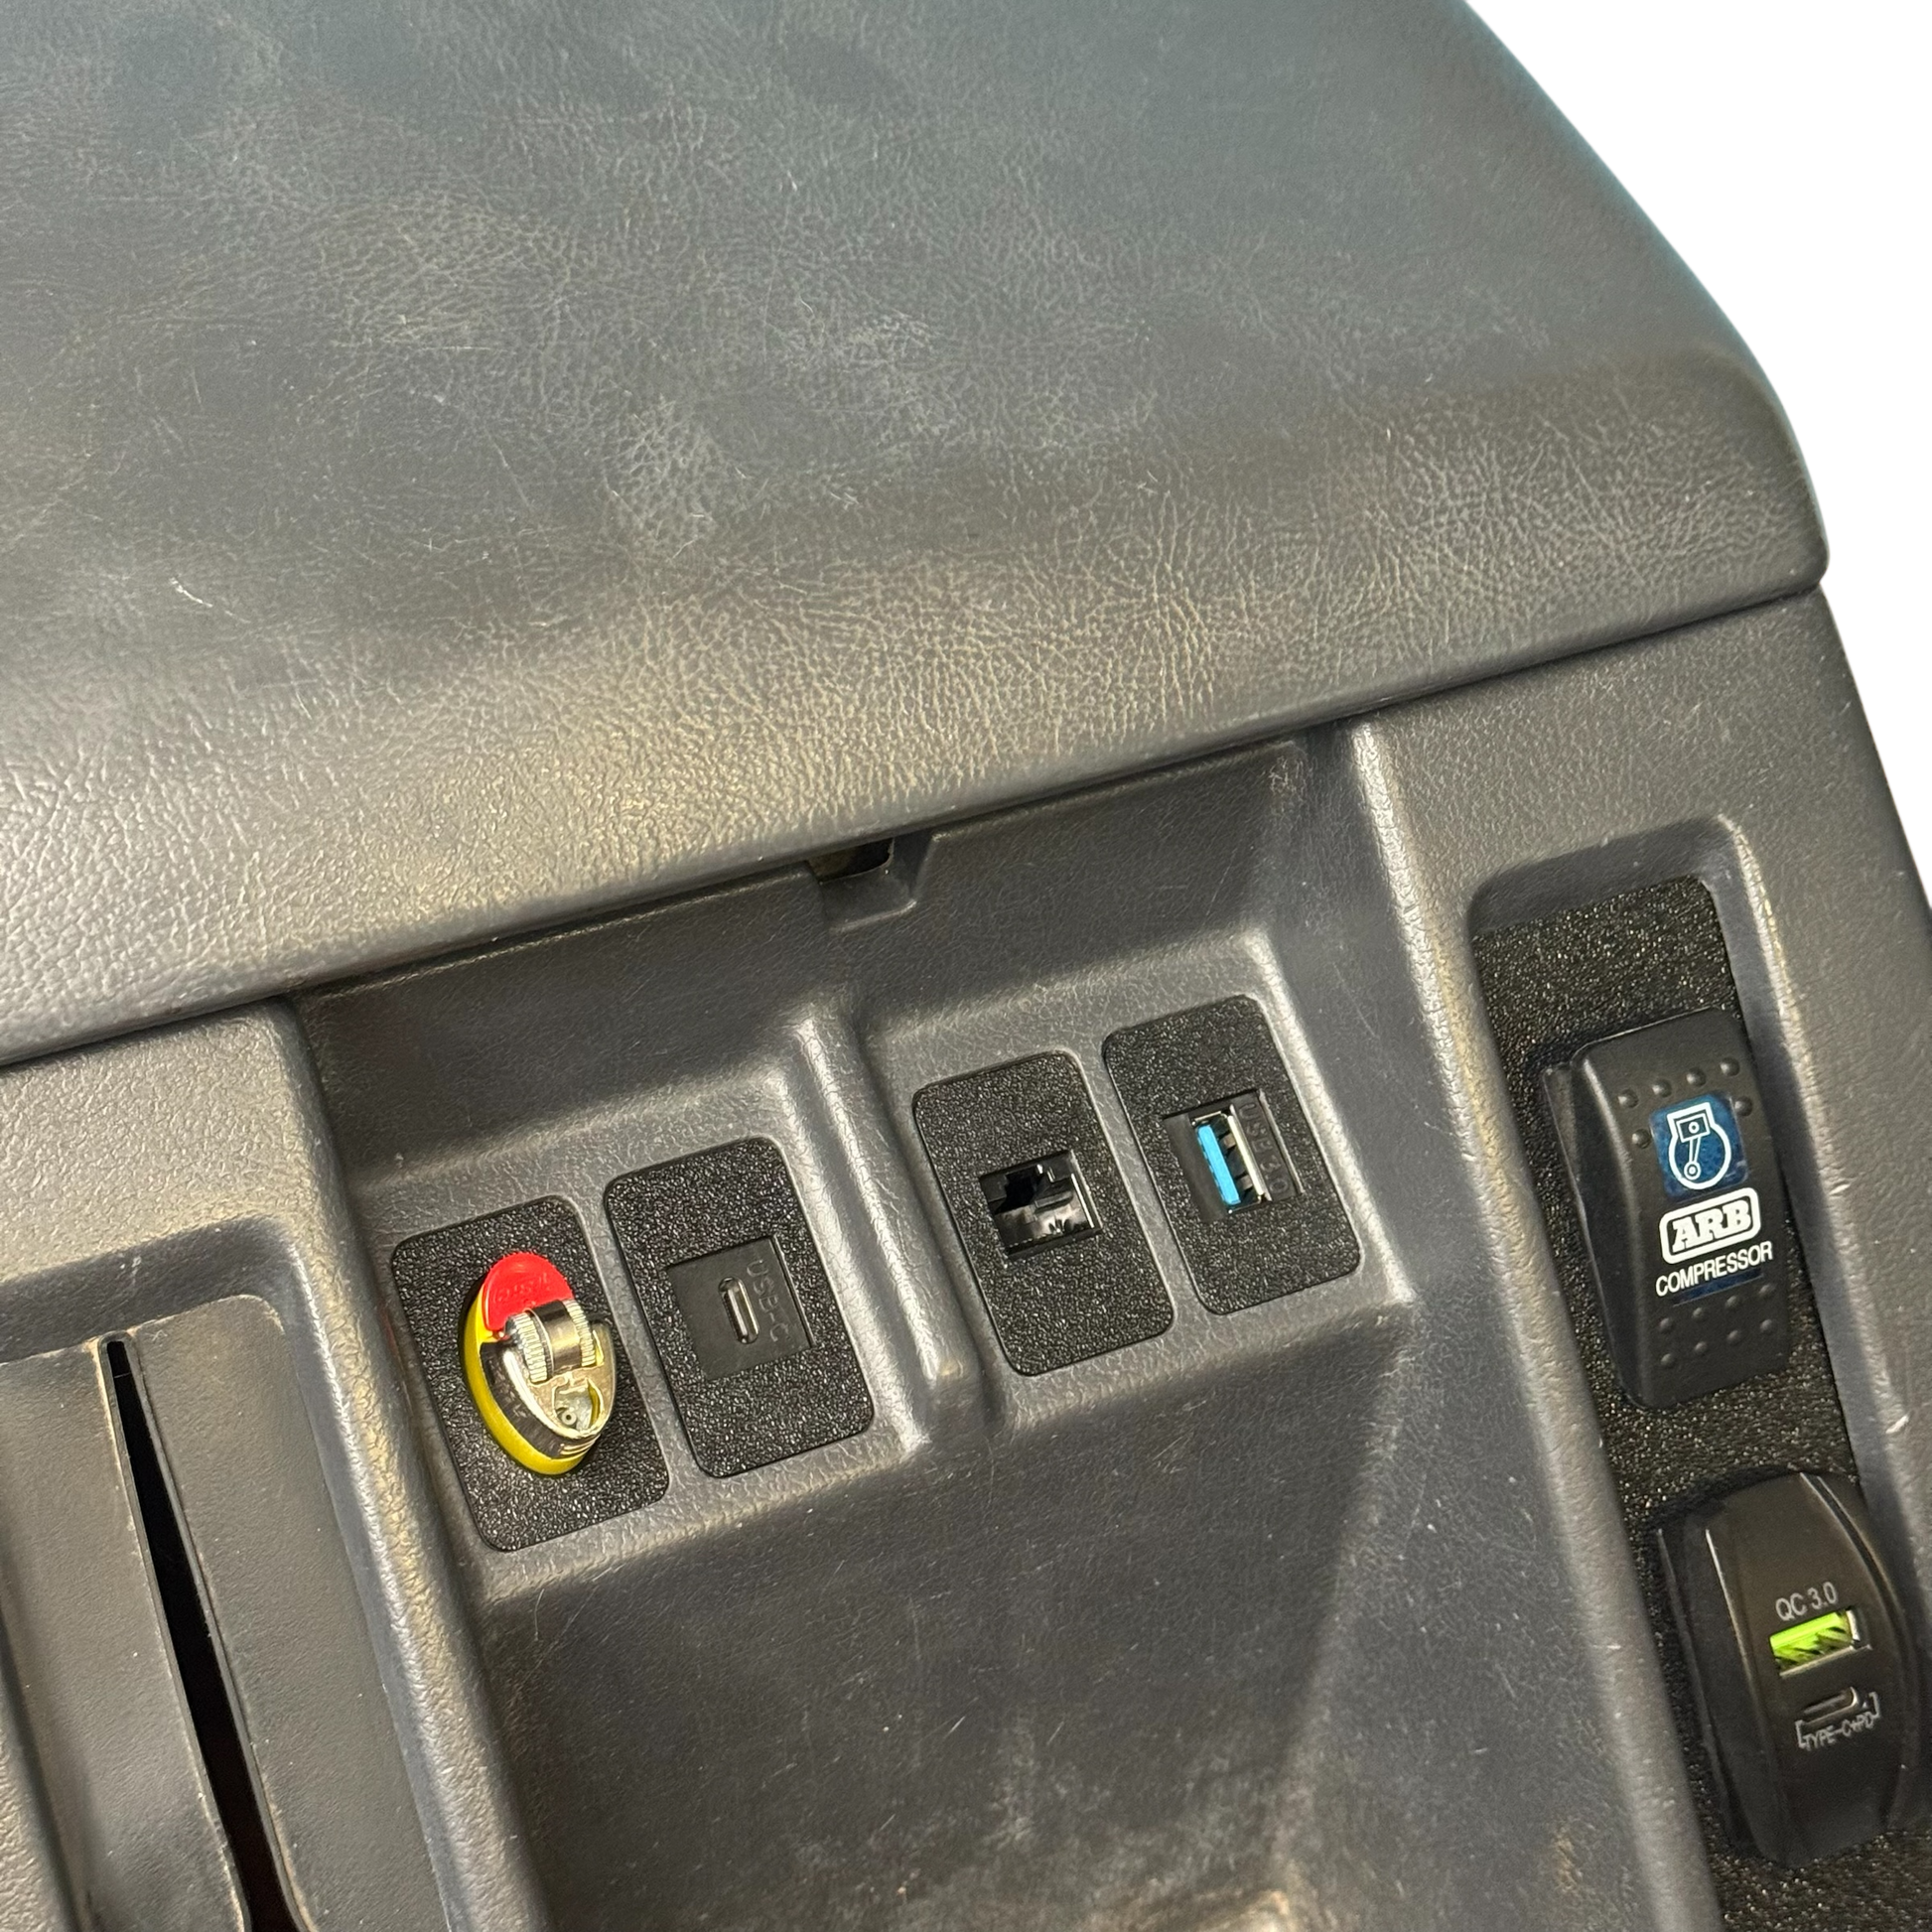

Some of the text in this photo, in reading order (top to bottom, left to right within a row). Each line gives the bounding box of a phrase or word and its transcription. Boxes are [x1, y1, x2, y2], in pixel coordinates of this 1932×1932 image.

[1239, 1103, 1273, 1153] USB
[1672, 1199, 1752, 1252] ARB
[1655, 1240, 1773, 1297] COMPRESSOR
[747, 1259, 791, 1342] USB-C
[1775, 1581, 1838, 1621] QC 3.0
